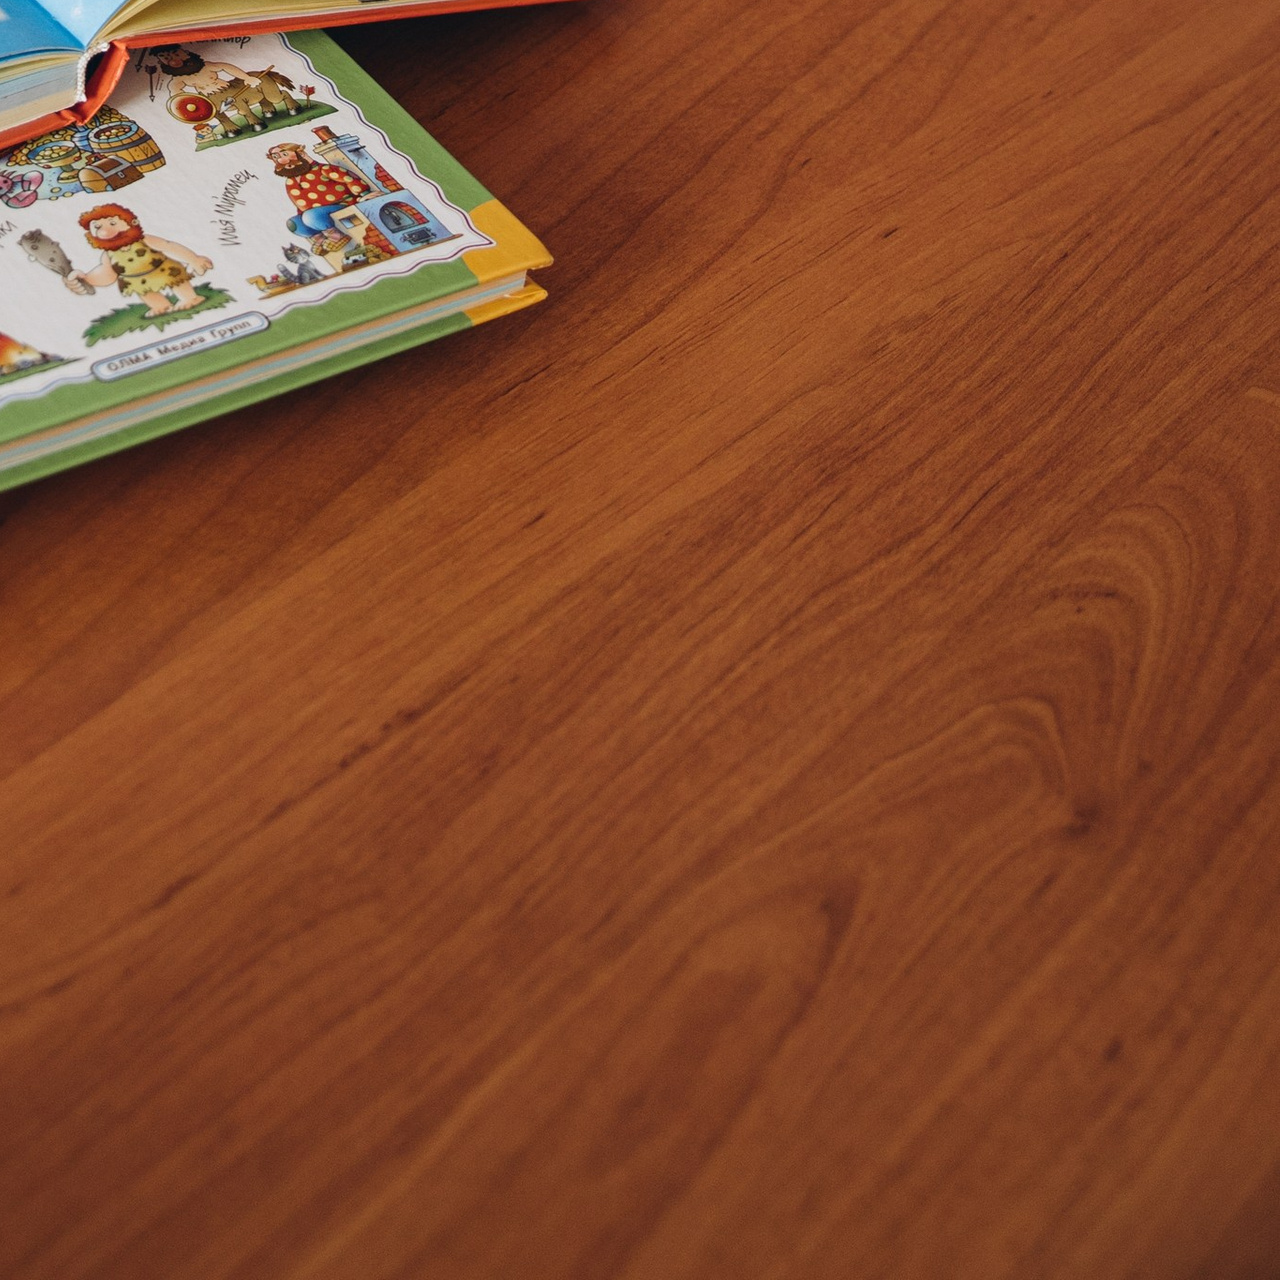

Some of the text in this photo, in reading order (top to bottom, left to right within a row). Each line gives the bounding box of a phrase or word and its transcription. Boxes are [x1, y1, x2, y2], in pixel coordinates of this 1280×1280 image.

[107, 321, 251, 372] ОЛМА Медиа Групп
